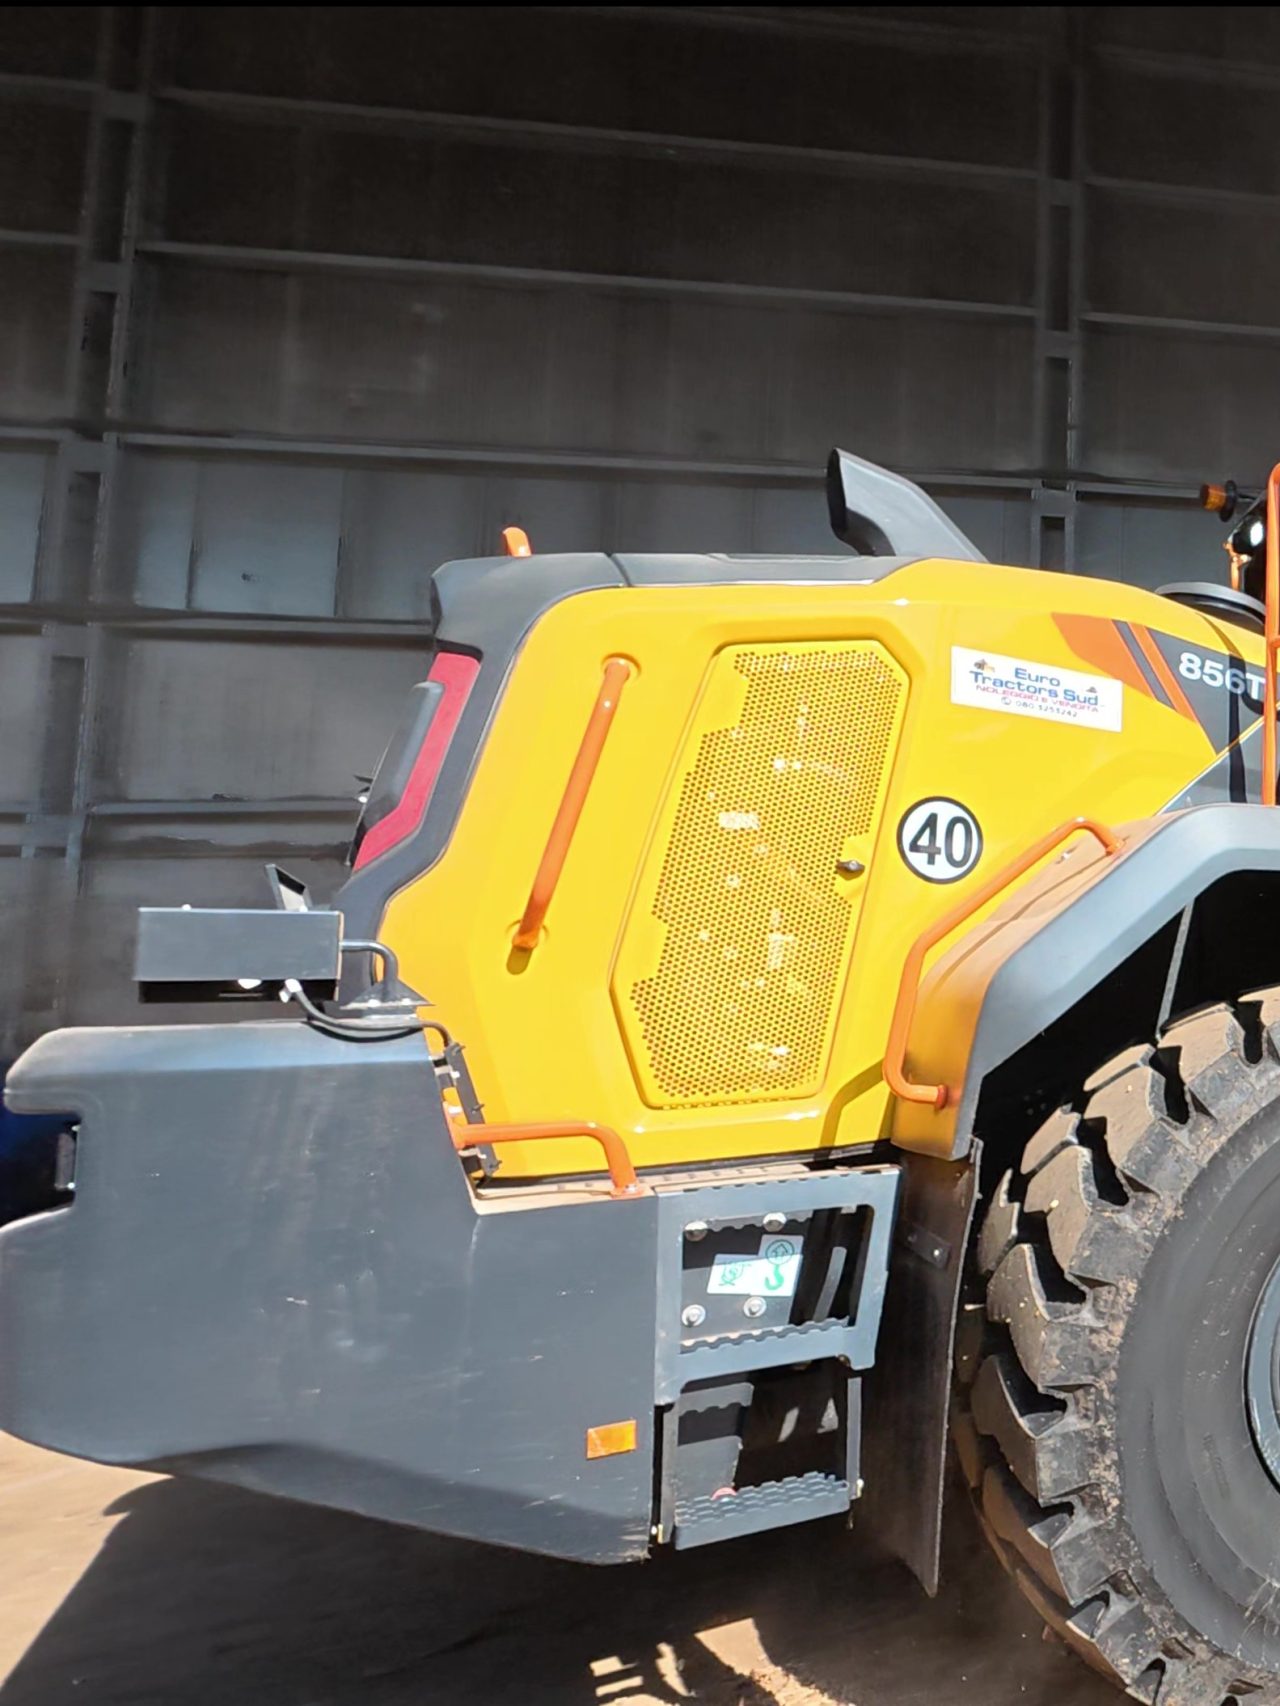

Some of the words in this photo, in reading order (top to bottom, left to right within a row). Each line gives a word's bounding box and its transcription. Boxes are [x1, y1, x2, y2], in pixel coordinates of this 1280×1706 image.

[969, 670, 1059, 698] Tractors
[1063, 688, 1099, 706] Sud
[1014, 667, 1061, 687] Euro
[1179, 652, 1267, 700] 856T
[976, 684, 1039, 702] NOLEGGIO
[1052, 699, 1099, 713] VENDITA
[908, 812, 973, 869] 40
